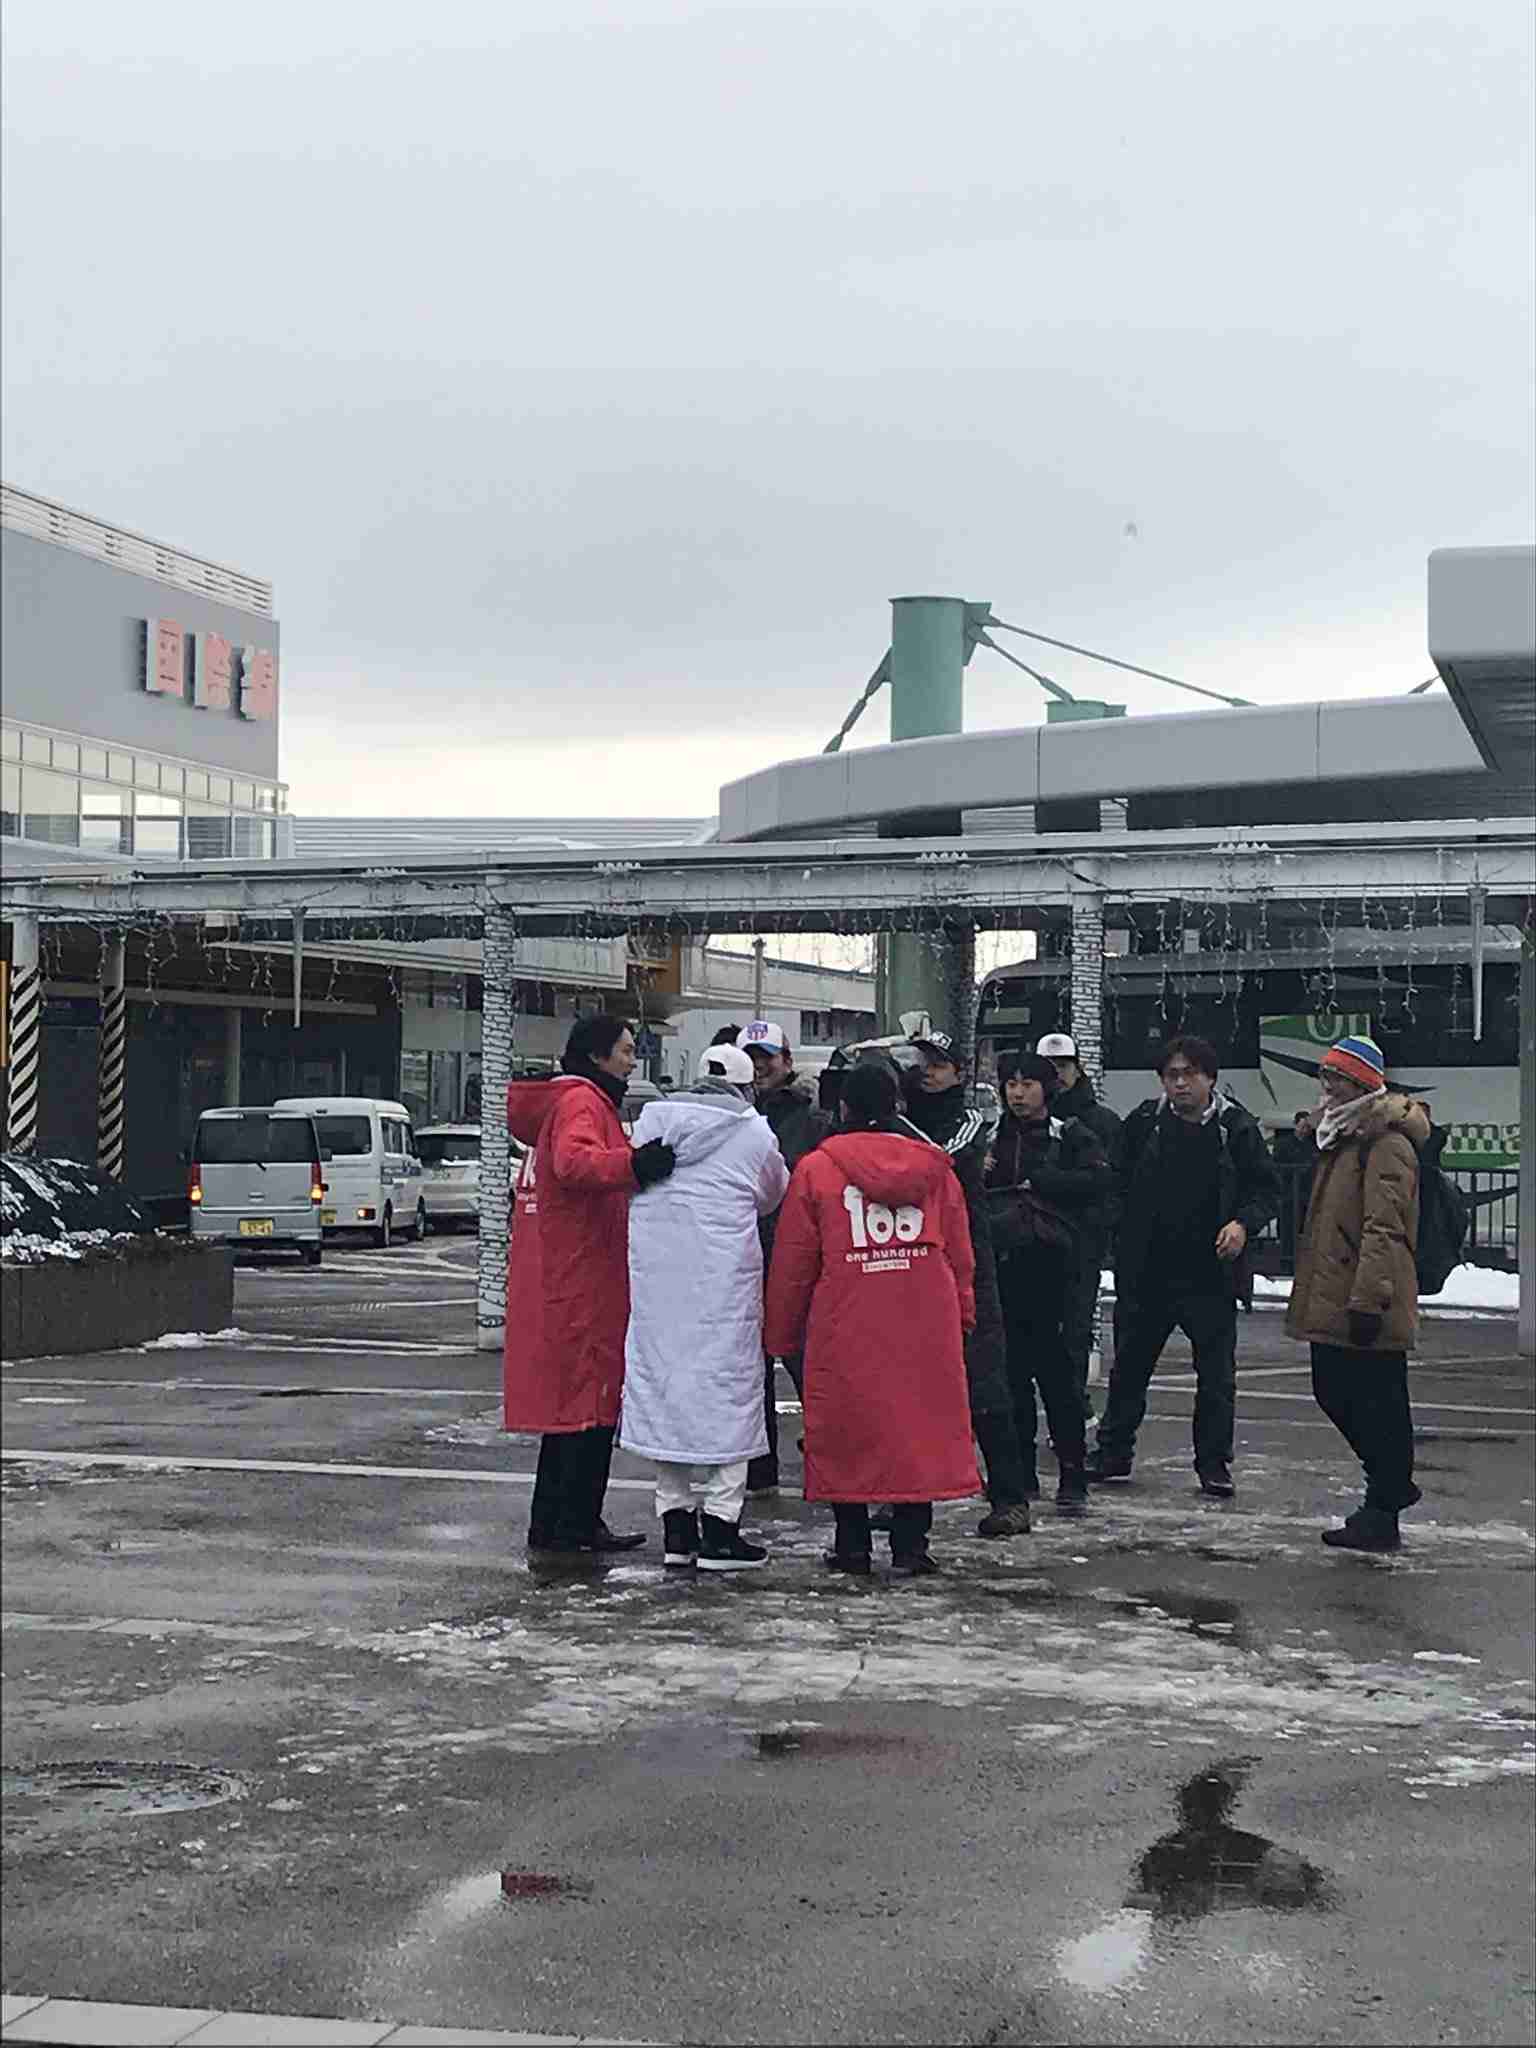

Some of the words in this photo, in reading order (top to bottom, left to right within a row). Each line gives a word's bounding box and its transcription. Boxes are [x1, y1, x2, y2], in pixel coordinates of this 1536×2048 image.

[843, 1185, 924, 1248] 100
[845, 1252, 869, 1262] one
[872, 1246, 929, 1259] hundred
